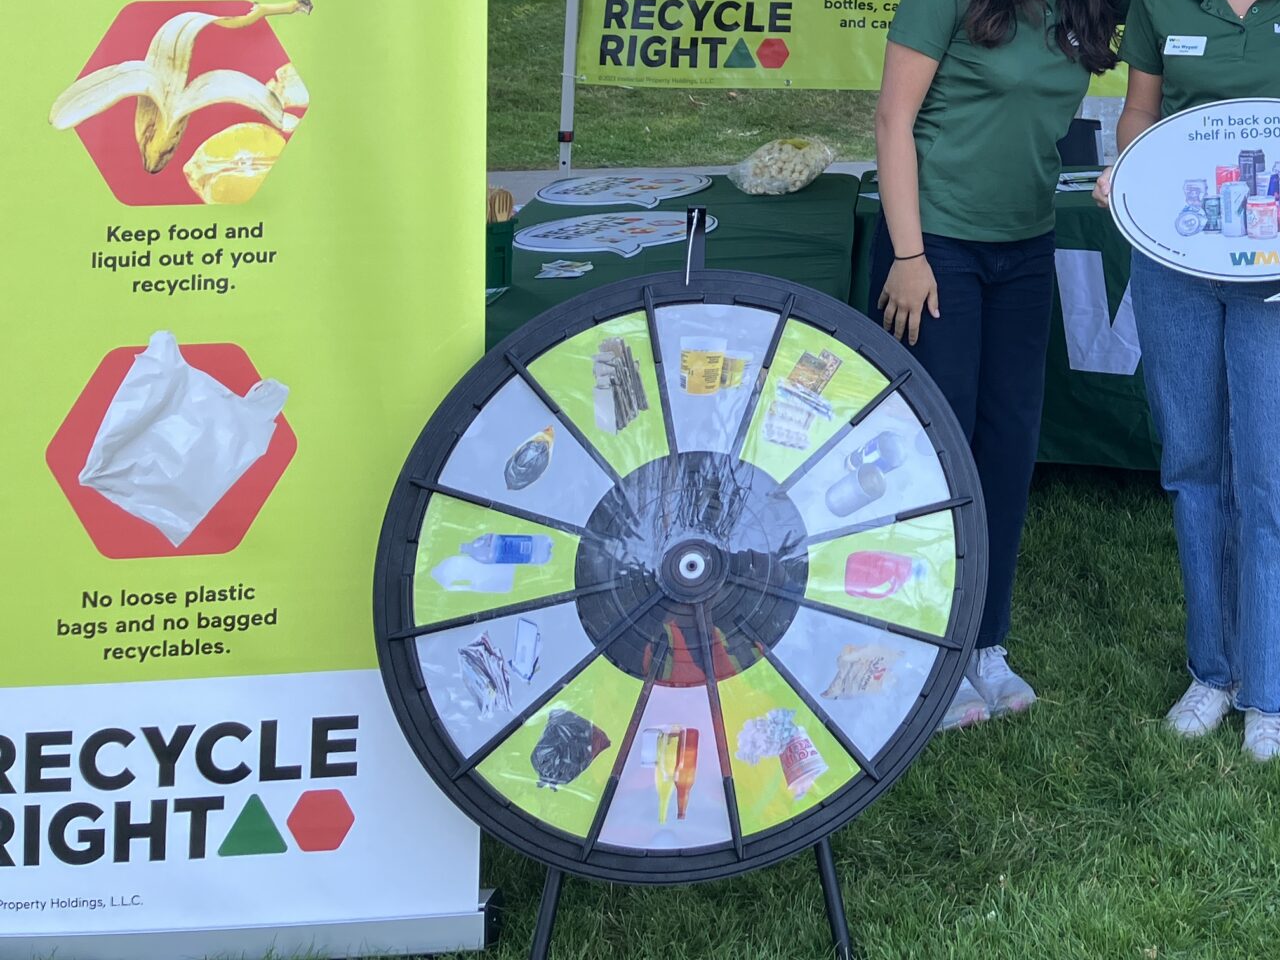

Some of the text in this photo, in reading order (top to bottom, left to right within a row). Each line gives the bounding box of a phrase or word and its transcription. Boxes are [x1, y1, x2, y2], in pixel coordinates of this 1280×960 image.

[840, 16, 866, 29] and
[599, 35, 727, 69] RIGHT
[1203, 115, 1224, 128] I'm
[1228, 114, 1259, 126] back
[1264, 116, 1280, 125] on
[1188, 127, 1220, 141] shelf
[1224, 128, 1236, 140] in
[107, 222, 264, 246] Keep food and
[92, 248, 277, 272] liquid out of your
[1230, 252, 1280, 266] WM
[132, 274, 236, 296] recycling.
[82, 583, 256, 609] No loose plastic
[57, 609, 277, 639] bags and no bagged
[103, 639, 231, 662] recyclables.
[51, 897, 106, 910] Holdings,
